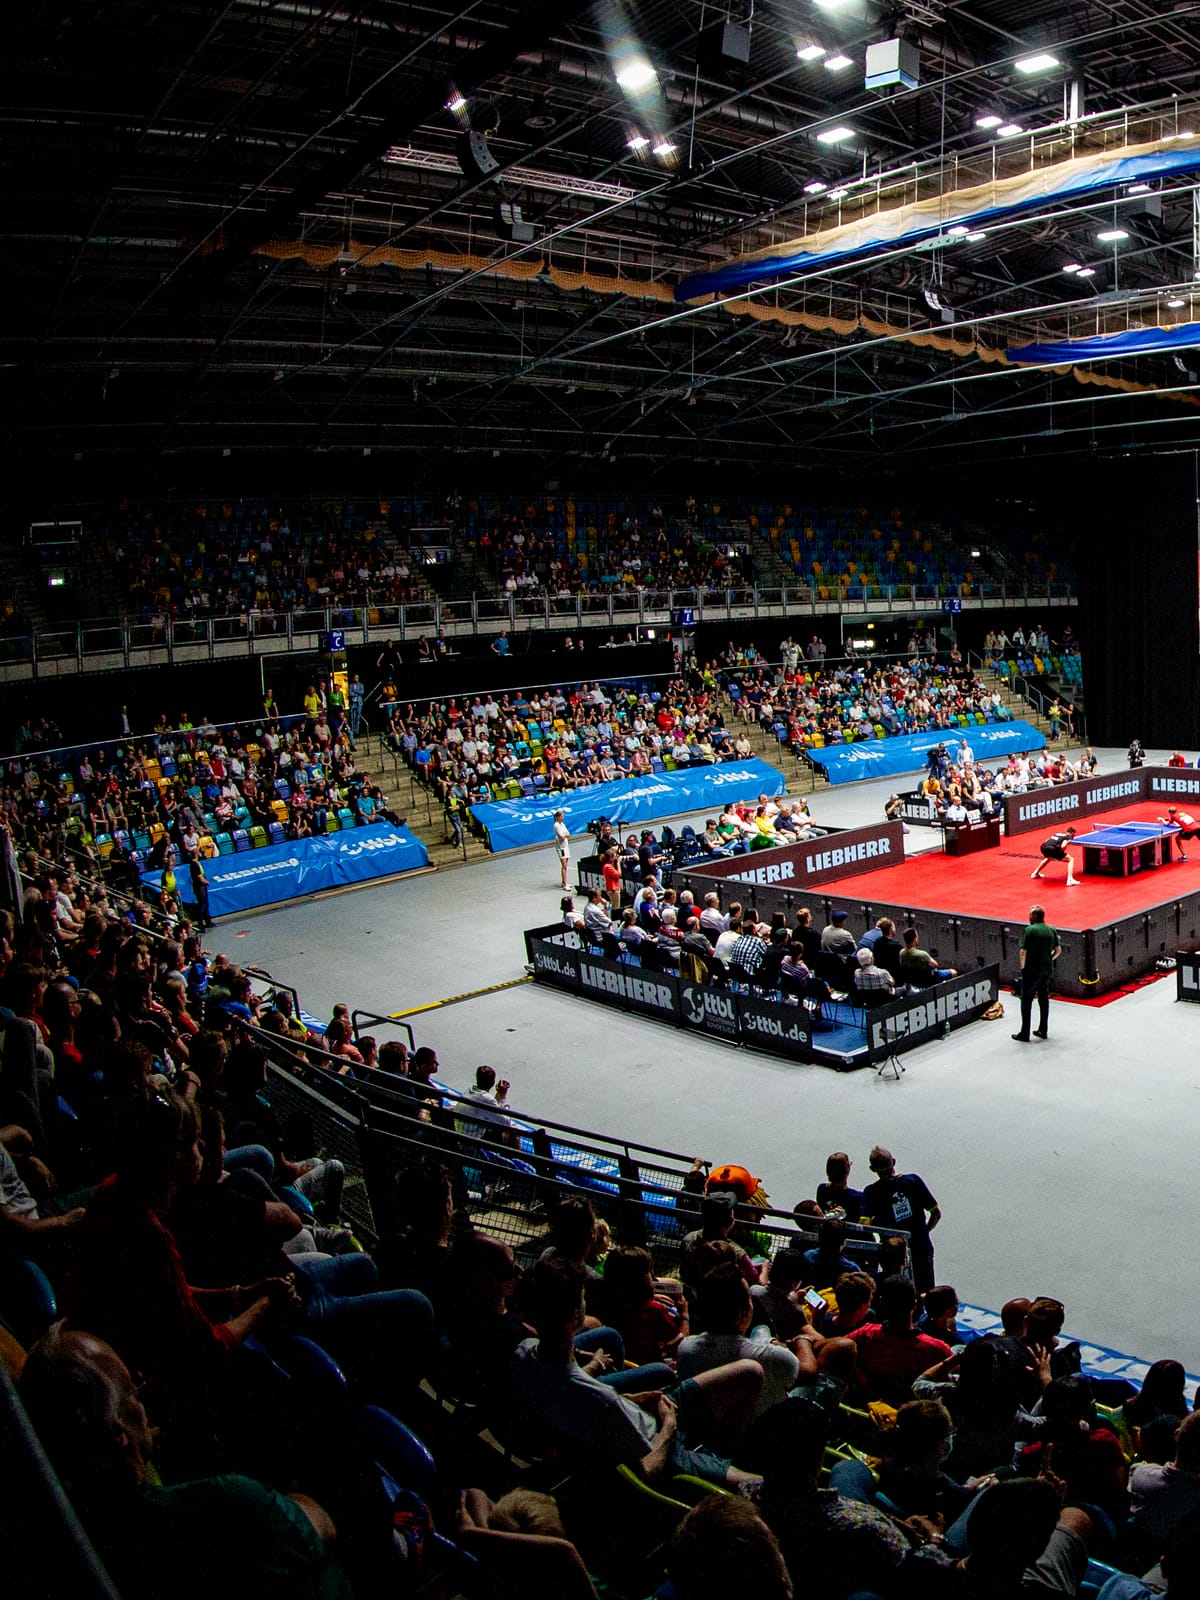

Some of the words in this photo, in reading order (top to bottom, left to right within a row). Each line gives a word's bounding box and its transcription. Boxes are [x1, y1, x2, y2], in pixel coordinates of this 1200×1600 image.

[1019, 794, 1079, 820] LIEBHERR
[1086, 780, 1140, 804] LIEBHERR
[806, 837, 892, 873] LIEBHERR
[542, 954, 576, 978] ttbl.de
[580, 962, 675, 1010] LIEBHERR
[703, 992, 735, 1020] ttbl
[872, 980, 992, 1048] LIEBHERR
[756, 1015, 808, 1043] ttbl.de
